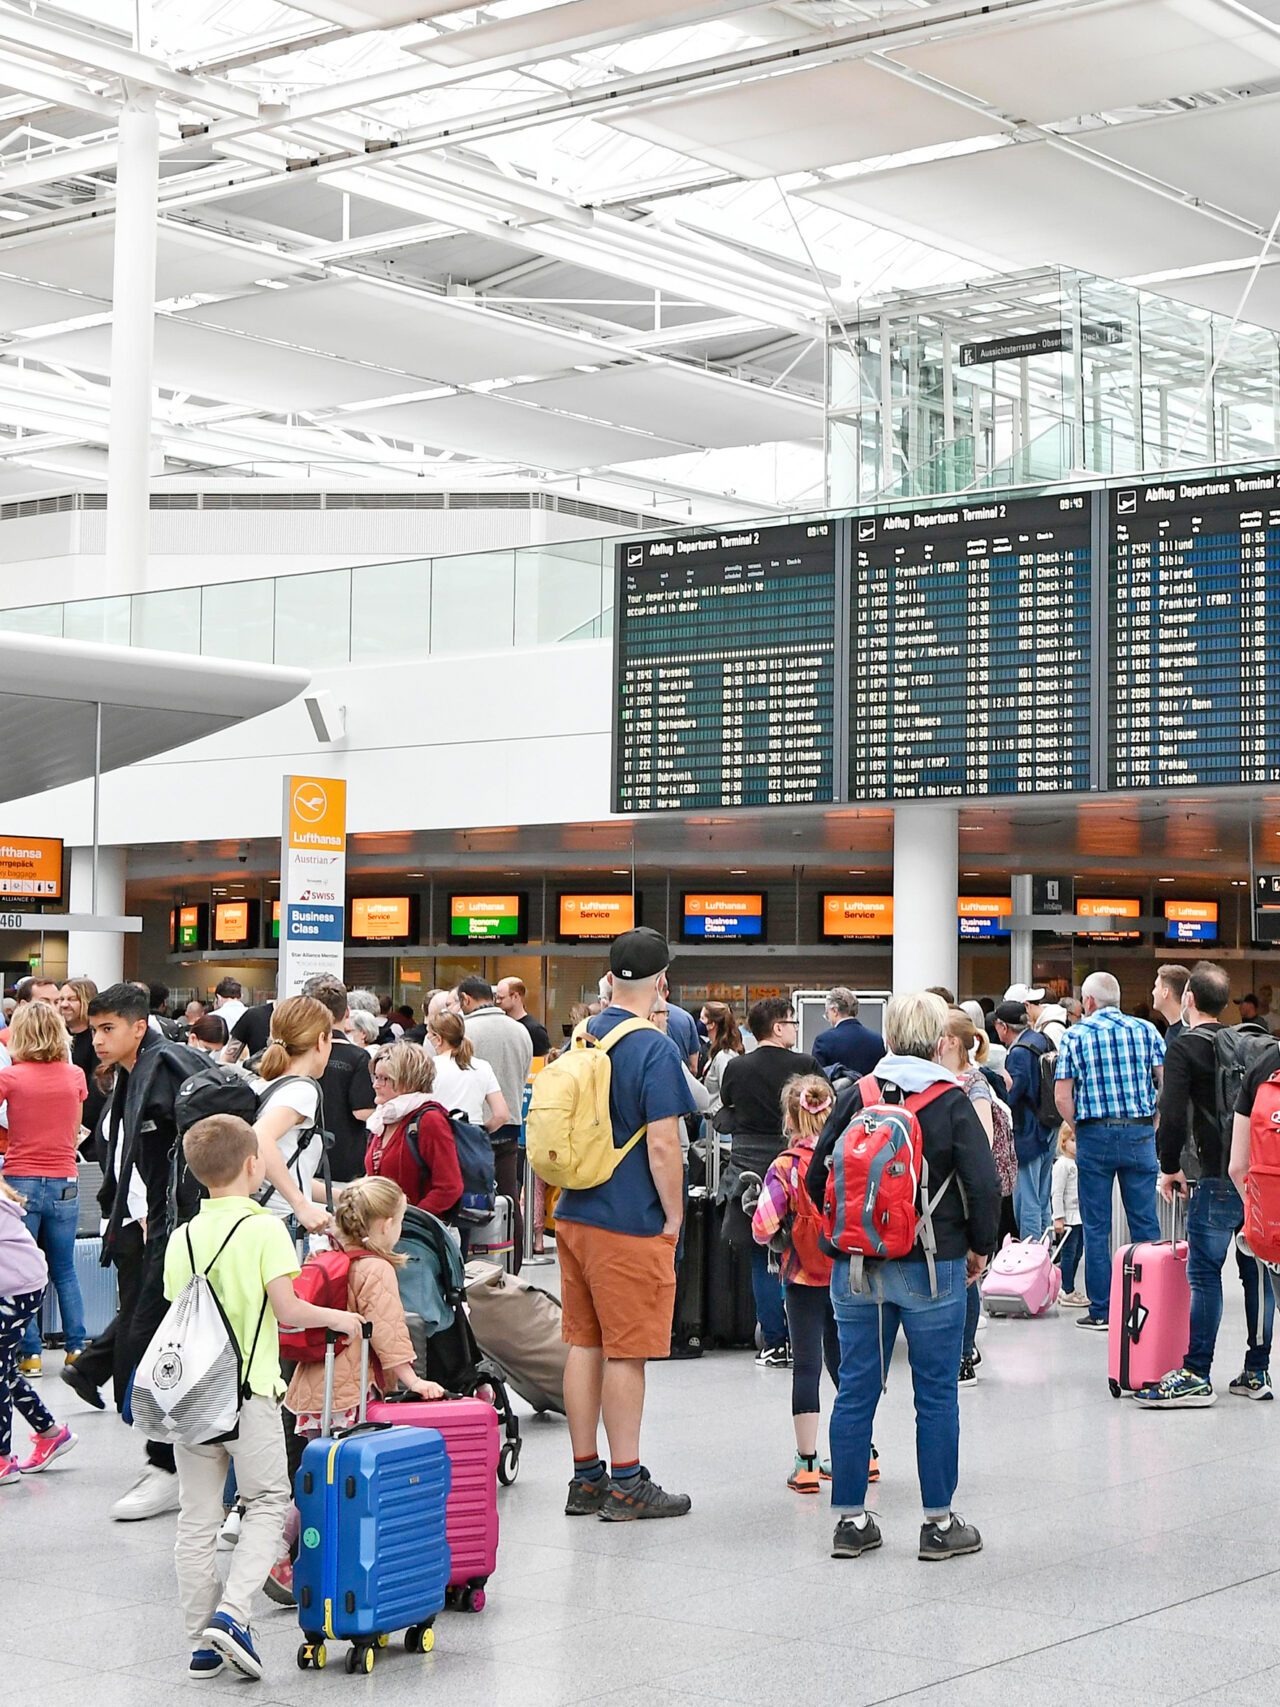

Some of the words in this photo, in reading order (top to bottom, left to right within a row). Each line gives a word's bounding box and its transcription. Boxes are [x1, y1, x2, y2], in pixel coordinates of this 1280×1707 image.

[981, 343, 1036, 357] Aussichtsterrasse
[1145, 487, 1175, 502] Abflug
[1180, 483, 1230, 499] Departures
[1234, 475, 1274, 492] Terminal
[883, 516, 910, 530] Abflug
[914, 513, 958, 528] Departures
[962, 506, 998, 521] Terminal
[1000, 505, 1006, 517] 2
[649, 543, 674, 556] Abflug
[677, 540, 717, 554] Departures
[720, 533, 752, 548] Terminal
[754, 532, 759, 544] 2
[1117, 573, 1127, 585] LH
[1132, 572, 1151, 583] 1734
[1241, 561, 1265, 574] 11:00
[755, 582, 764, 591] be
[293, 831, 342, 845] Lufthansa
[294, 854, 328, 864] Austrian
[312, 892, 335, 901] SWISS
[469, 903, 505, 911] Lufthansa
[580, 902, 620, 910] Lufthansa
[705, 901, 746, 910] Lufthansa
[843, 902, 885, 911] Lufthansa
[960, 903, 999, 911] Lufthansa
[292, 910, 334, 922] Business
[367, 913, 390, 921] Service
[580, 911, 610, 919] Service
[844, 910, 875, 919] Service
[469, 917, 500, 927] Economy
[704, 917, 738, 925] Business
[960, 918, 991, 927] Business
[291, 923, 319, 934] Class
[704, 924, 726, 933] Class
[960, 925, 980, 934] Class
